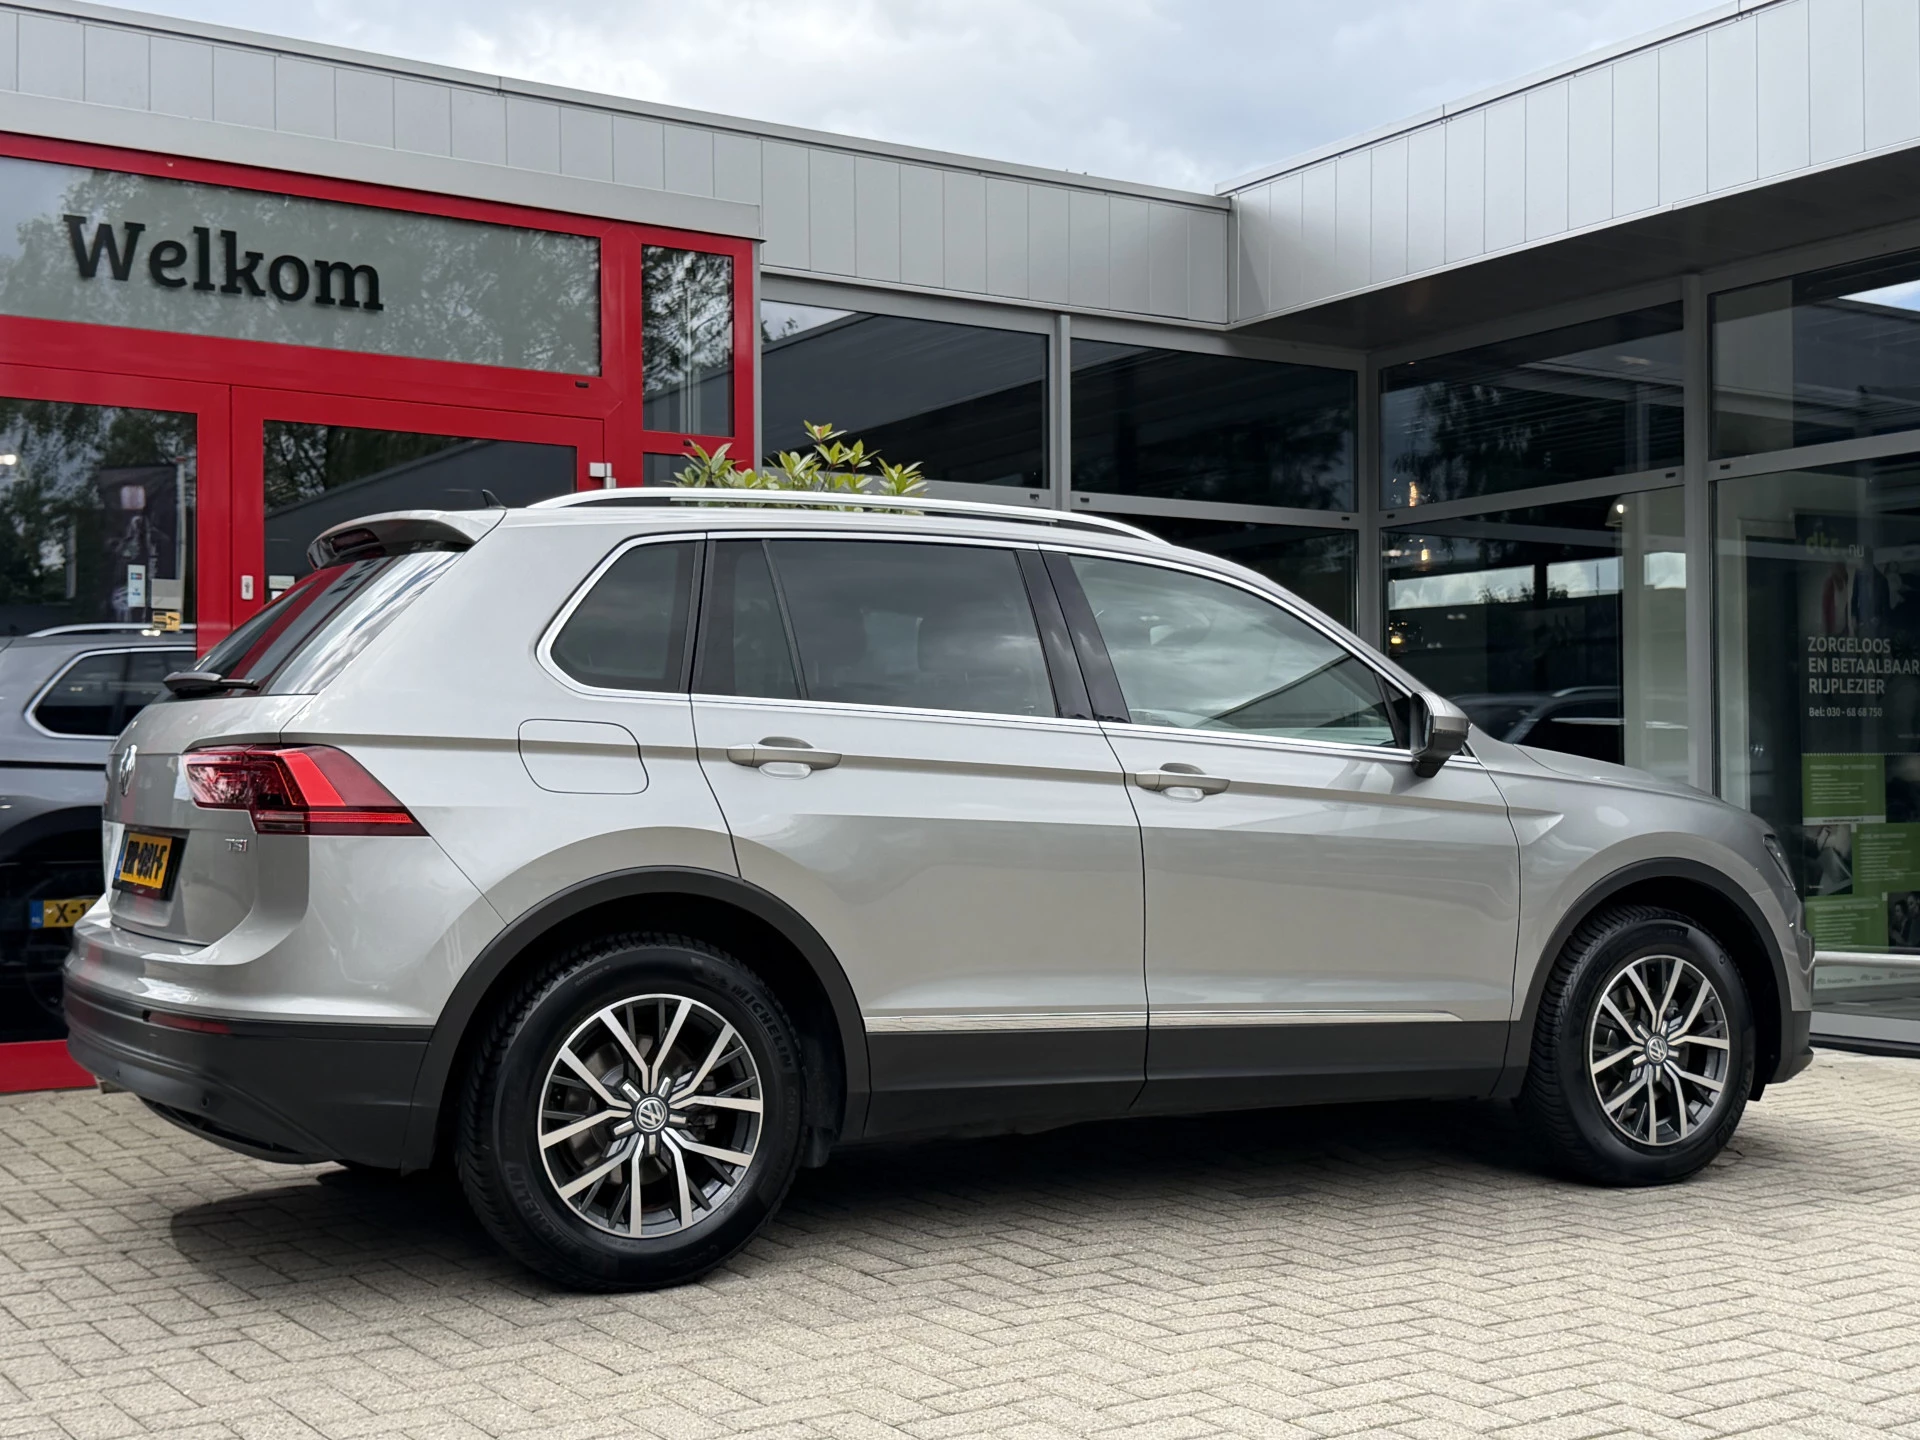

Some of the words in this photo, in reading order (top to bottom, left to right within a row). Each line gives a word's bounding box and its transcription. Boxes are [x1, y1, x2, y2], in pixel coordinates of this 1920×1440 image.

[63, 214, 384, 311] Welkom
[1807, 636, 1891, 654] ZORGELOOS
[1808, 657, 1828, 673] EN
[1831, 657, 1920, 675] BETAALBAAR
[1808, 678, 1885, 695] RIJPLEZIER
[1808, 706, 1825, 717] Bel:
[1826, 707, 1841, 717] 030
